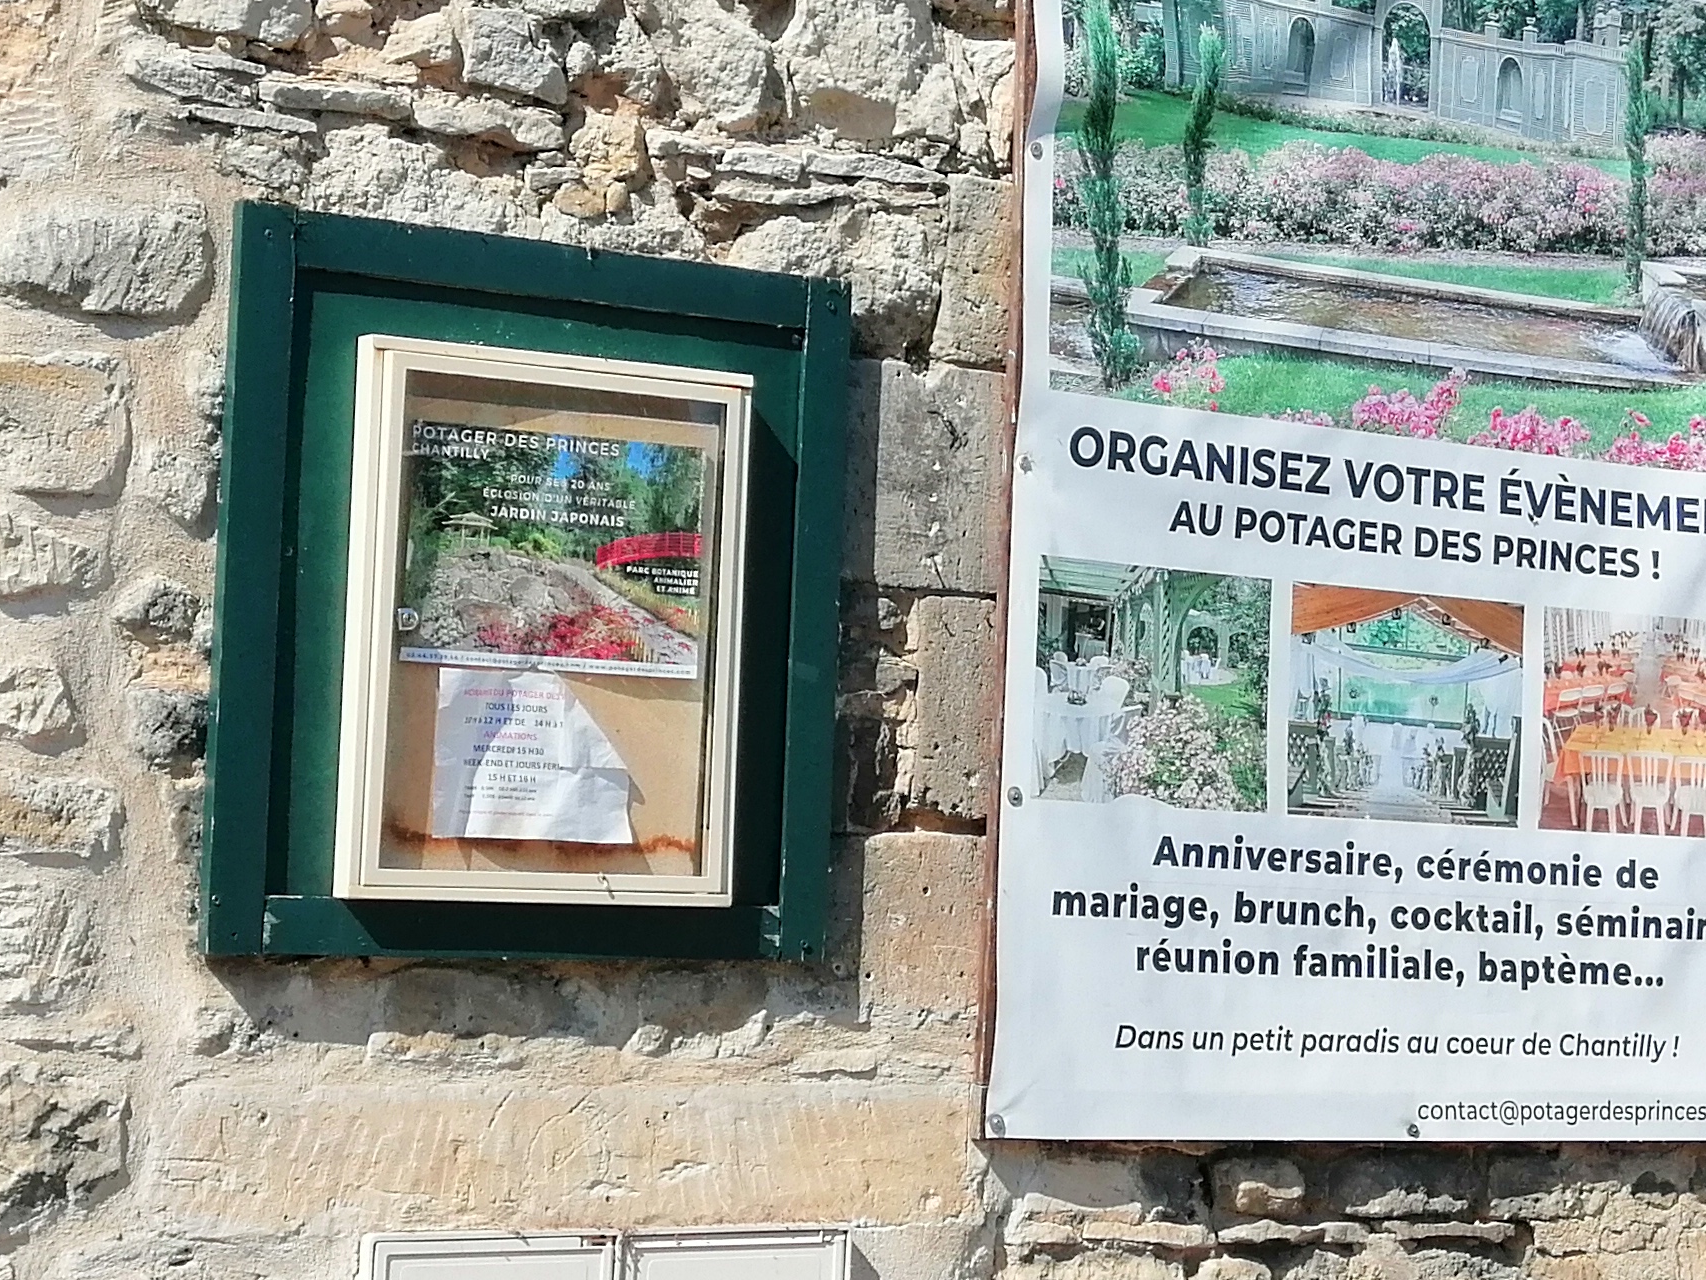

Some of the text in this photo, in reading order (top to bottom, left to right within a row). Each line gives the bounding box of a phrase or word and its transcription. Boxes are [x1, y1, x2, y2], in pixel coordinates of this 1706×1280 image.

[413, 425, 620, 457] POTAGER DES PRINCES
[412, 442, 490, 460] CHANTILLY
[1070, 426, 1331, 495] ORGANISEZ
[1343, 459, 1485, 513] VOTRE
[511, 474, 542, 486] POUR
[570, 479, 585, 490] 20
[588, 481, 611, 492] ANS
[483, 486, 636, 509] ÉCLOSION D'UN VÉRITABLE
[490, 505, 625, 528] JARDIN JAPONAIS
[1169, 501, 1660, 580] AU POTAGER DES PRINCES !
[626, 565, 699, 578] PARC BOTANIQUE
[654, 576, 699, 587] ANIMALIER
[506, 689, 544, 699] POTAGER
[486, 702, 505, 711] TOUS
[522, 704, 548, 713] JOURS
[515, 718, 526, 726] DE
[484, 731, 538, 741] ANIMATIONS
[473, 744, 515, 754] MERCREDI
[505, 760, 513, 768] ET
[515, 761, 541, 770] JOURS
[508, 774, 516, 782] ET
[1152, 834, 1659, 890] Anniversaire, cérémonie de
[1051, 882, 1219, 928] mariage,
[1234, 891, 1377, 934] brunch,
[1391, 900, 1543, 941] cocktail,
[1136, 938, 1664, 990] réunion familiale, baptème...
[1114, 1024, 1680, 1063] Dans un petit paradis au coeur de Chantilly !
